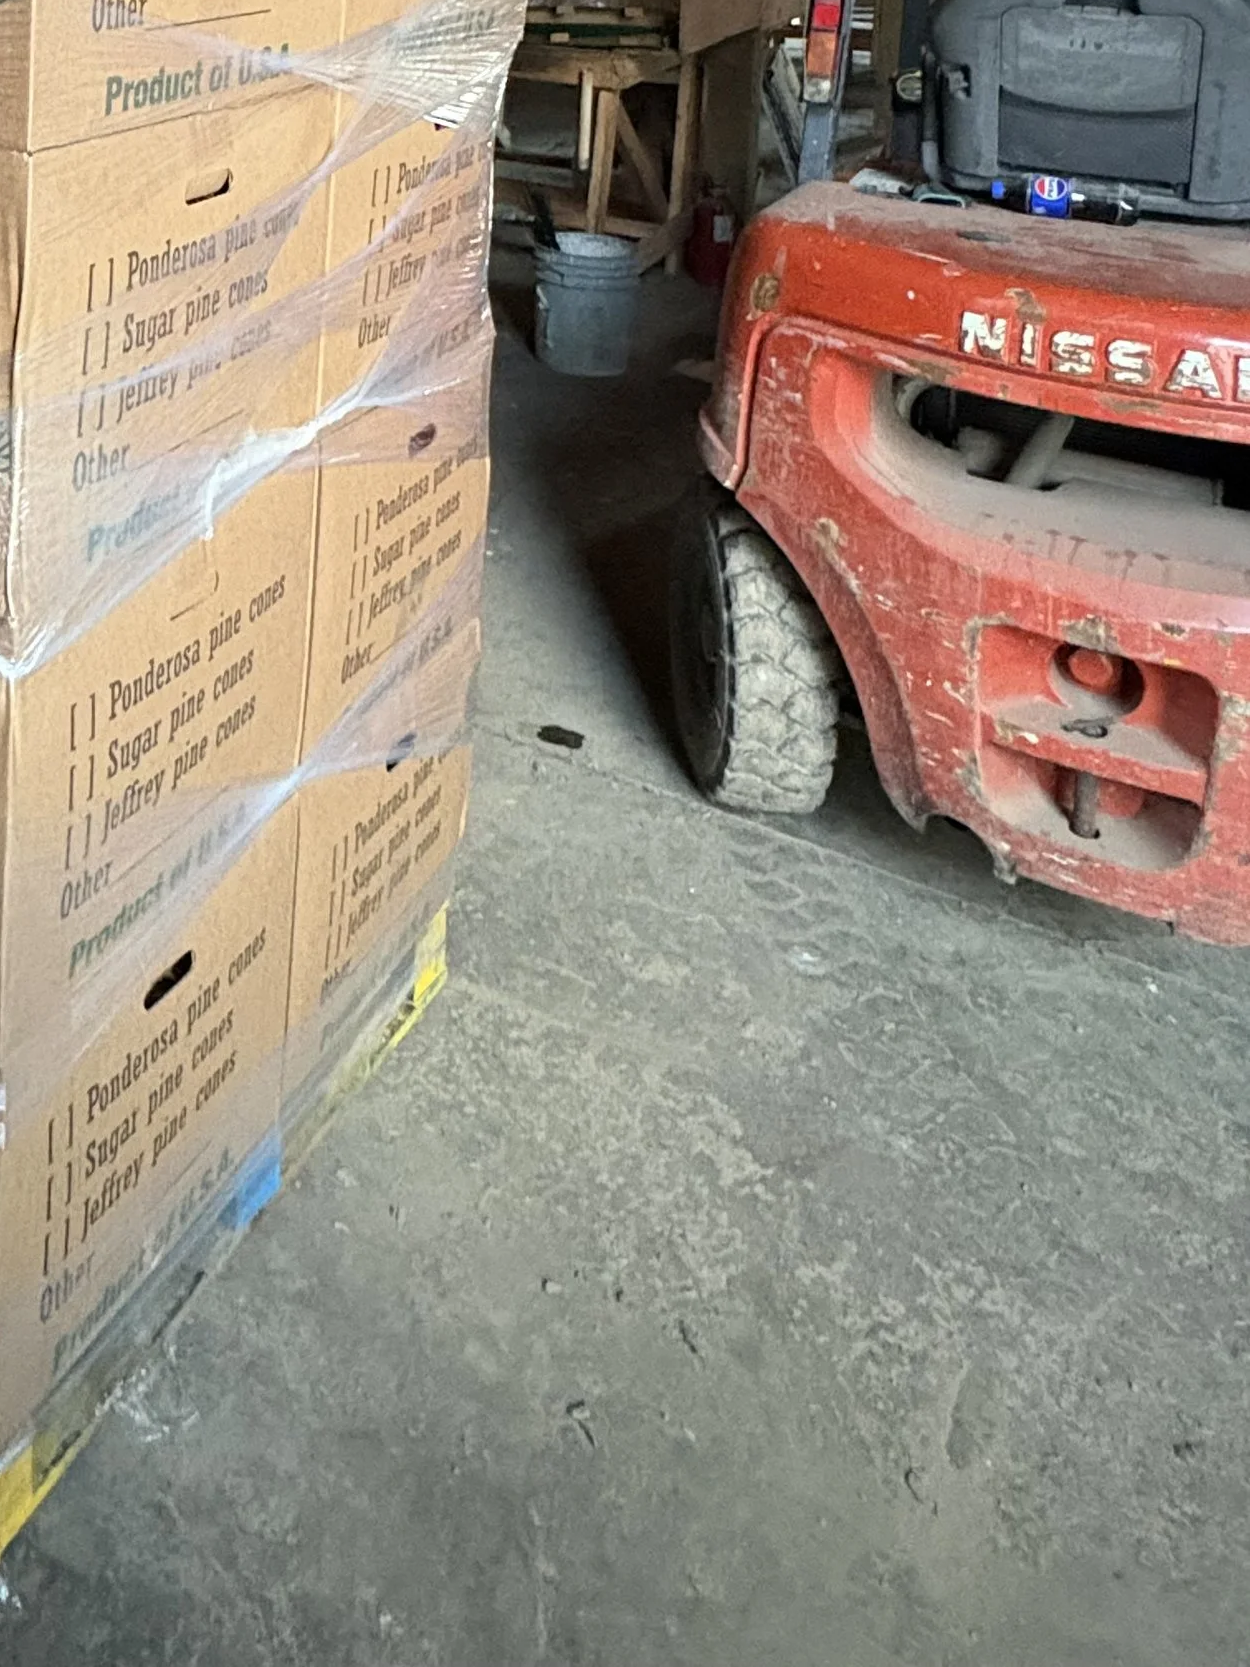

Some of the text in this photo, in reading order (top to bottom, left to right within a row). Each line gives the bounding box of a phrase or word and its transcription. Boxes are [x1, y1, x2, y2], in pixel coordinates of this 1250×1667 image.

[105, 61, 203, 116] Product
[209, 55, 233, 92] of
[127, 238, 216, 292] Ponderosa
[224, 214, 256, 263] pine
[122, 269, 269, 355] Sugar pine cones
[358, 314, 391, 349] Other
[958, 310, 1250, 404] NISSA
[72, 443, 130, 493] Other
[108, 574, 286, 721] Ponderosa pine cones
[107, 648, 254, 779] Sugar pine cones
[101, 694, 256, 845] Jeffrey pine cones
[60, 859, 113, 920] Other
[87, 926, 266, 1125] Ponderosa pine cones
[85, 1008, 234, 1180] Sugar pine cones
[81, 1049, 237, 1244] Jeffrey pine cones
